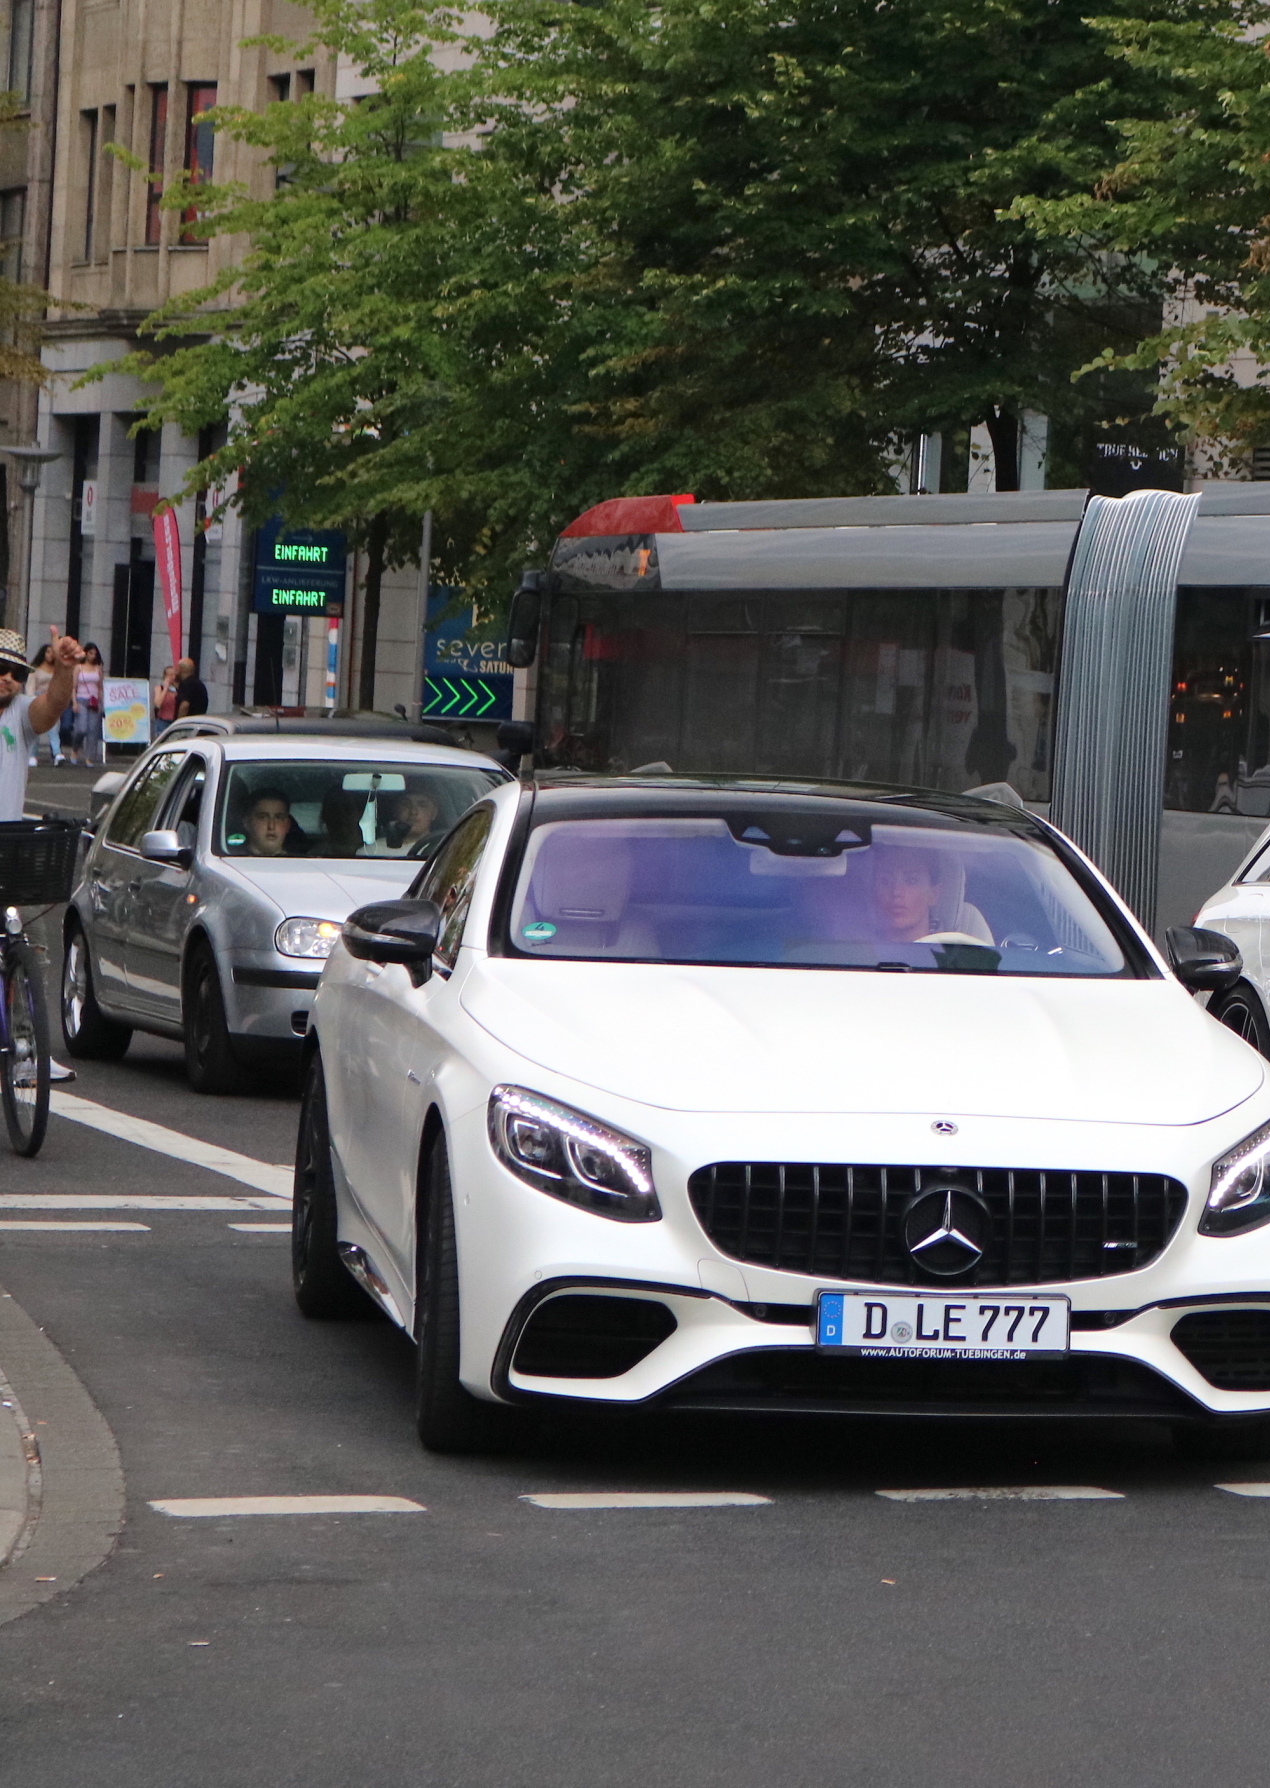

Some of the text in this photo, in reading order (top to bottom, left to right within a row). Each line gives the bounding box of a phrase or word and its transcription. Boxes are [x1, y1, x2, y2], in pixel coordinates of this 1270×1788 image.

[274, 544, 328, 562] EINFAHRT
[272, 588, 326, 607] EINFAHRT
[826, 1324, 836, 1337] D
[862, 1302, 1050, 1343] D LE 777
[861, 1347, 1026, 1360] www.AUTOFORUM-TUEBINGEN.de
